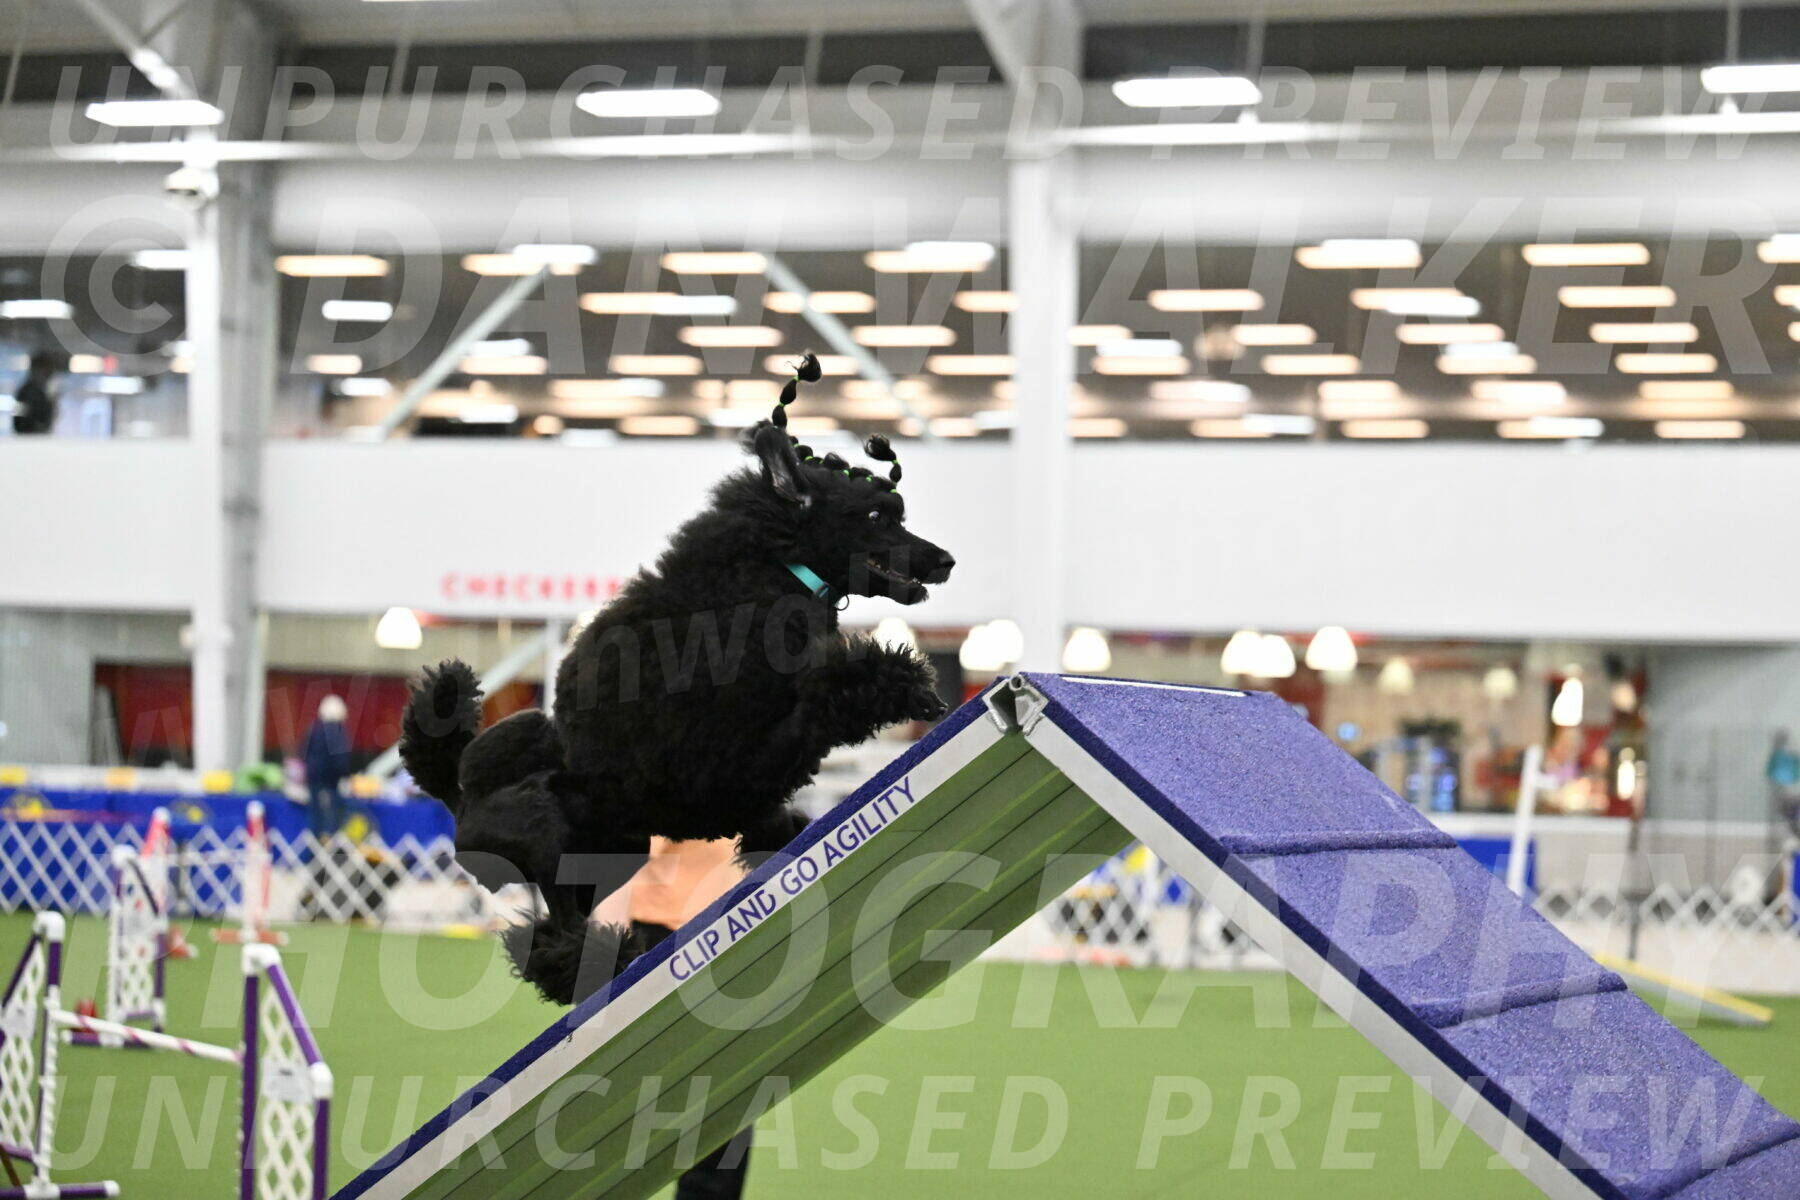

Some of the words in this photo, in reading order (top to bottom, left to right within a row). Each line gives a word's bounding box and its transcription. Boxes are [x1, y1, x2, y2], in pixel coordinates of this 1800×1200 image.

[669, 929, 720, 981] CLIP
[727, 888, 777, 942] AND
[780, 856, 819, 895] GO
[823, 776, 916, 868] AGILITY
